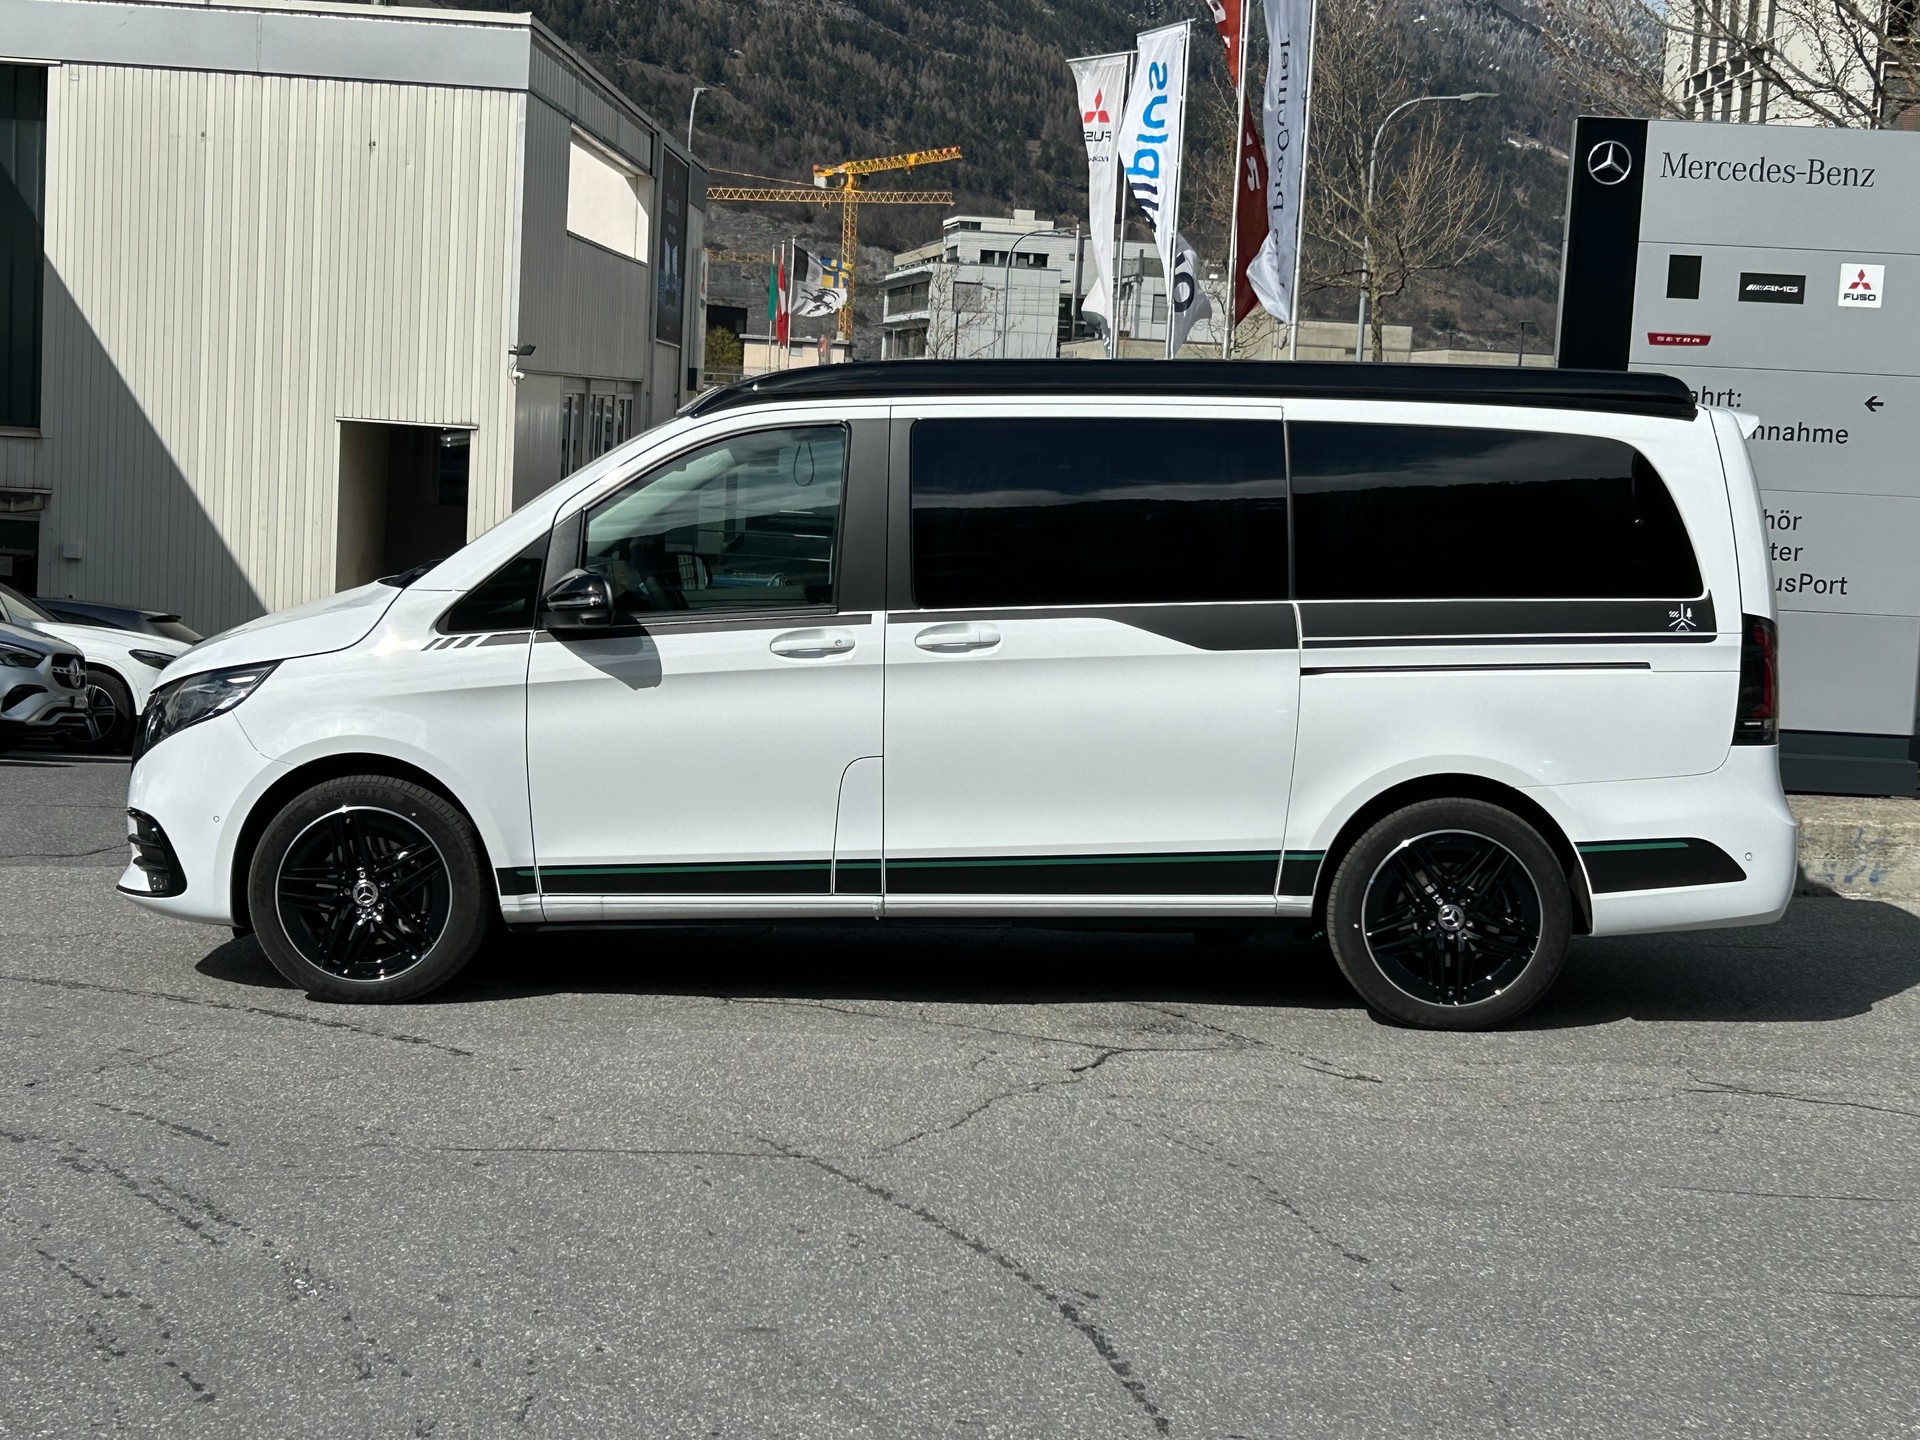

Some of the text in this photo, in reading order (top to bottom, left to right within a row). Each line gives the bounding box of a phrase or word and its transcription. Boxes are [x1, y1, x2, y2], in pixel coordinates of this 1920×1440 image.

[1660, 151, 1876, 188] Mercedes-Benz
[1843, 292, 1877, 302] FUSO
[1690, 385, 1742, 408] ahrt:
[1752, 421, 1849, 444] nnahme
[1764, 508, 1802, 531] hör
[1769, 542, 1804, 562] ter
